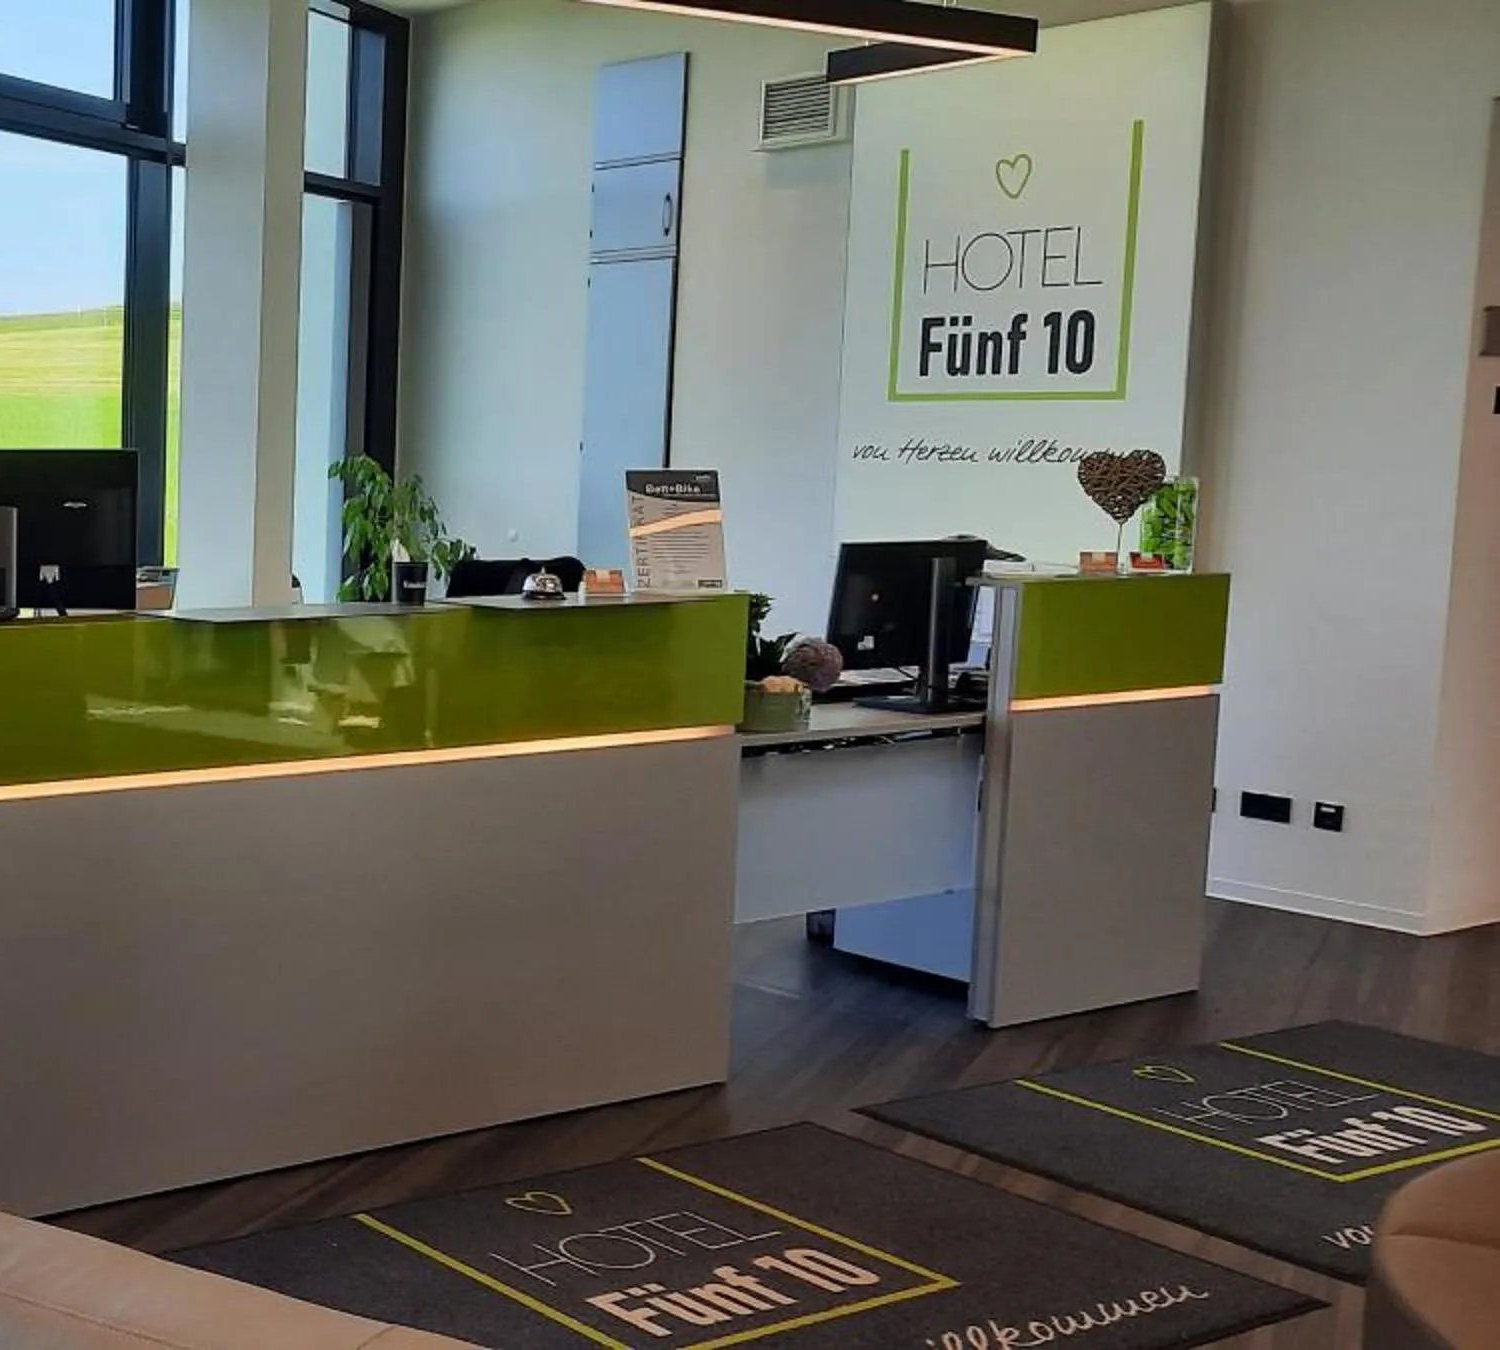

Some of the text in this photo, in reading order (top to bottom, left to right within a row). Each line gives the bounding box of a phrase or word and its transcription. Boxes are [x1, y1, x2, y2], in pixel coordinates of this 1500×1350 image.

[922, 226, 1103, 294] HOTEL
[918, 309, 1096, 377] Fünf 10
[852, 444, 890, 462] von
[900, 438, 979, 464] Herzen
[1152, 1080, 1381, 1131] HOTEL
[1254, 1105, 1488, 1164] Fünf 10
[488, 1211, 782, 1287] HOTEL
[582, 1247, 882, 1338] Fünf 10
